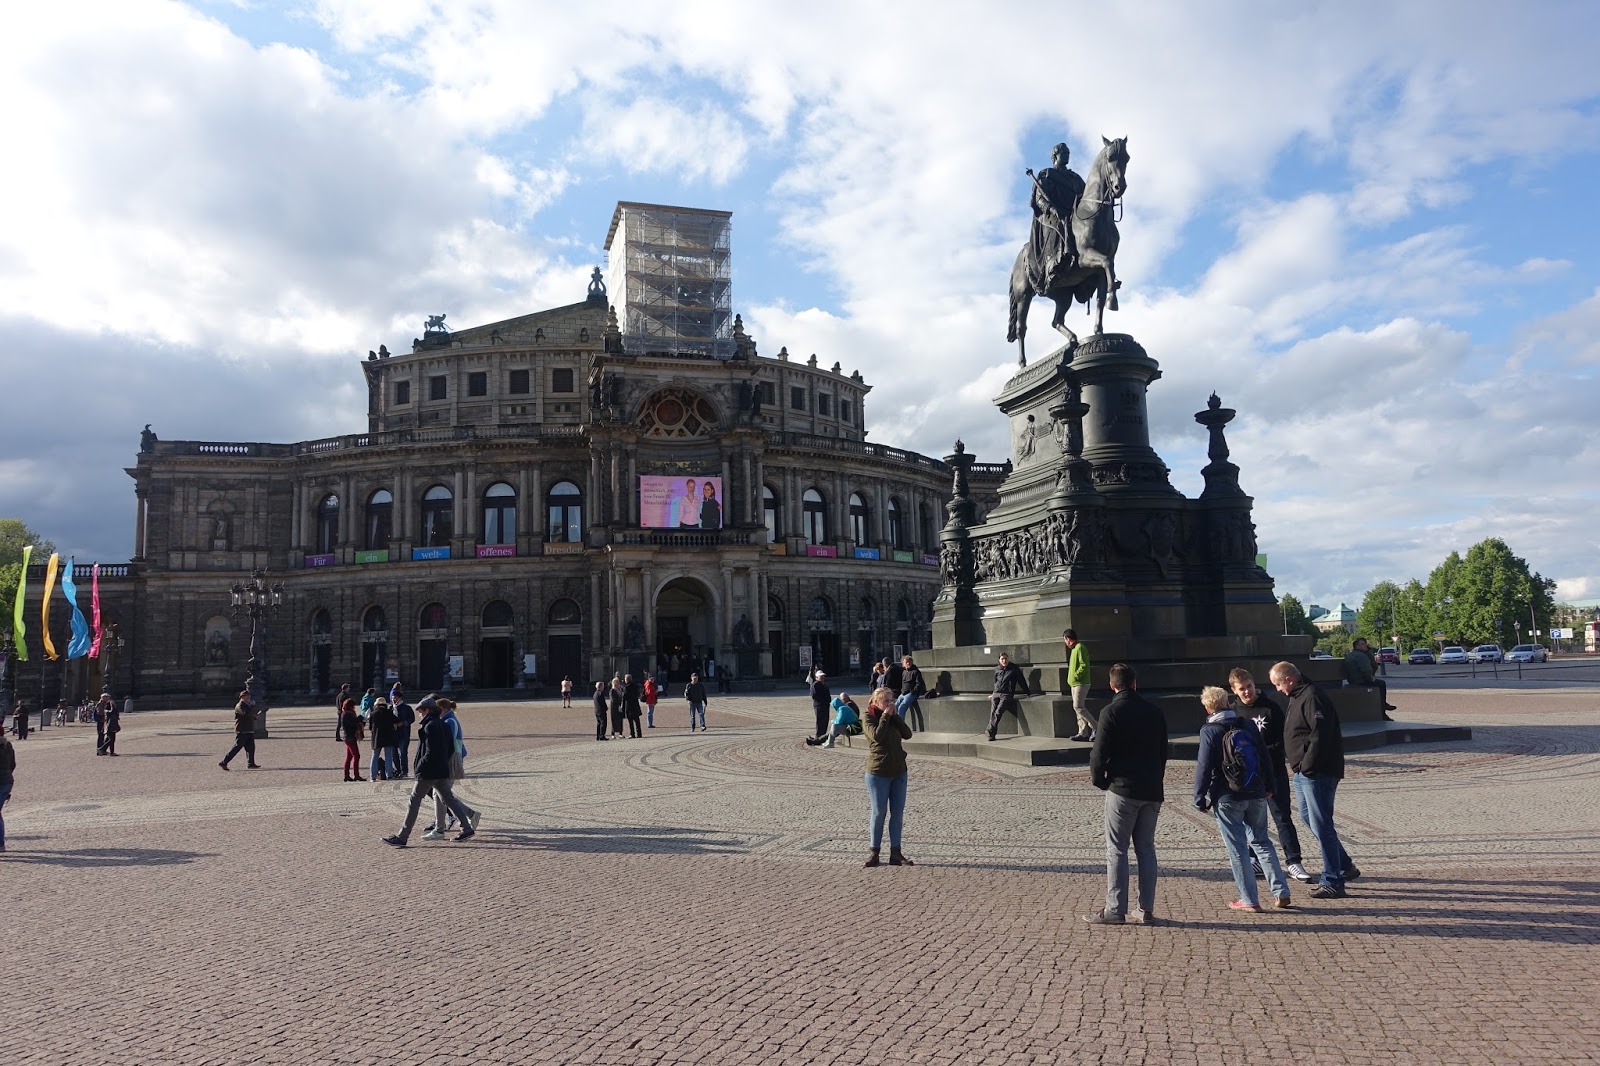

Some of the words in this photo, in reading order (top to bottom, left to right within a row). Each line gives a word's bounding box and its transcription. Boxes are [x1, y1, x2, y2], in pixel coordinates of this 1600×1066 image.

[421, 550, 442, 559] welt-
[480, 547, 513, 557] offenes
[545, 545, 583, 555] Dresden
[816, 548, 828, 556] ein
[313, 557, 326, 566] Für
[366, 554, 378, 562] ein
